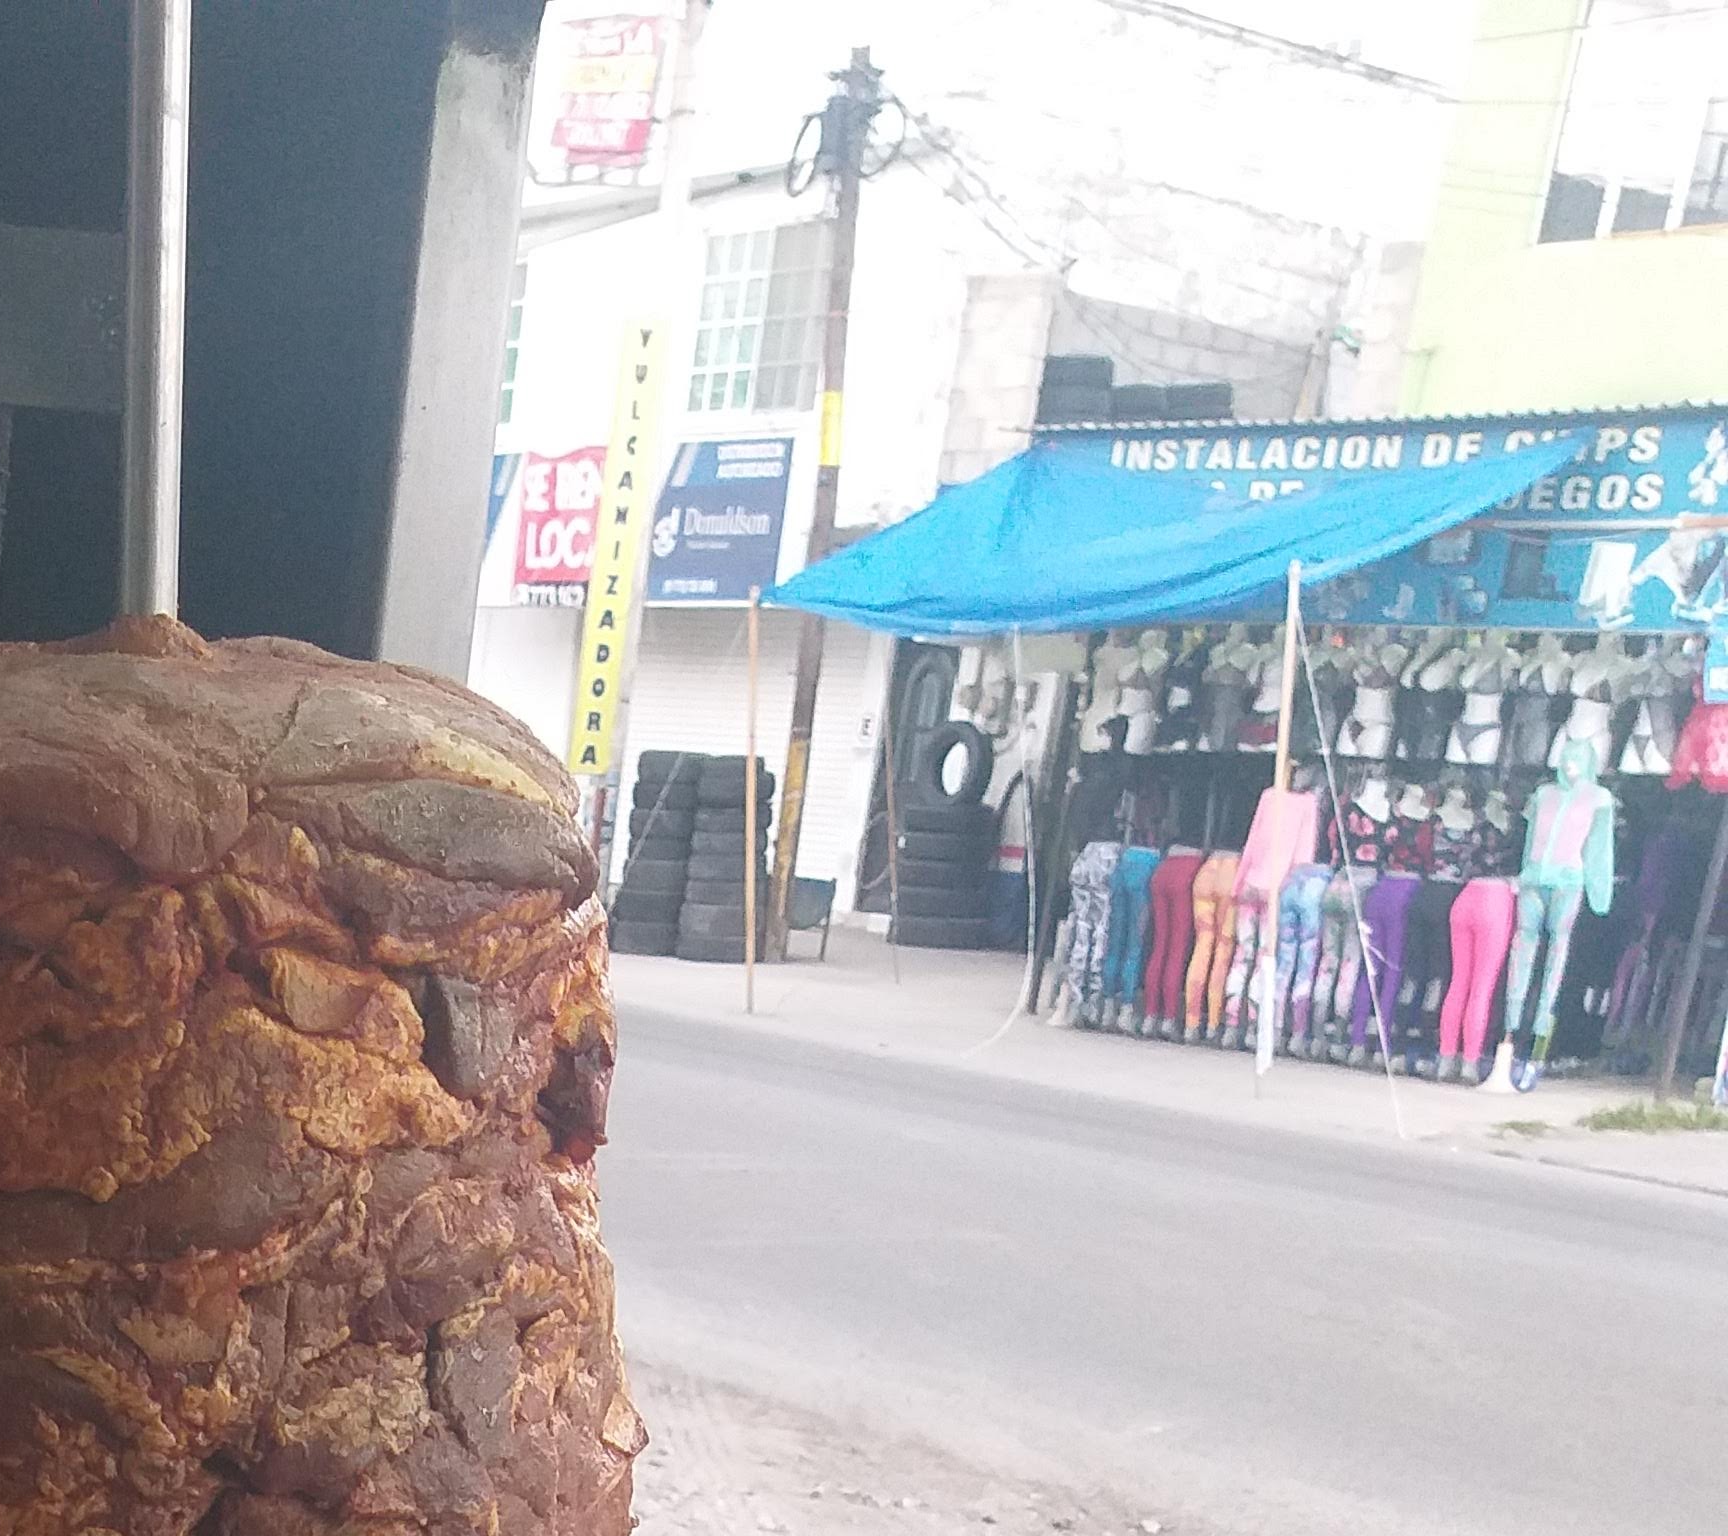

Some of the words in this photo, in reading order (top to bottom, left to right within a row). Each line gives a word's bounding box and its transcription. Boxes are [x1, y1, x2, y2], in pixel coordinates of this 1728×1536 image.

[1111, 435, 1404, 471] INSTALACION
[1421, 430, 1484, 468] DE
[524, 516, 595, 570] LOC
[684, 505, 770, 535] Donaldson
[580, 328, 653, 765] VULCANIZADORA
